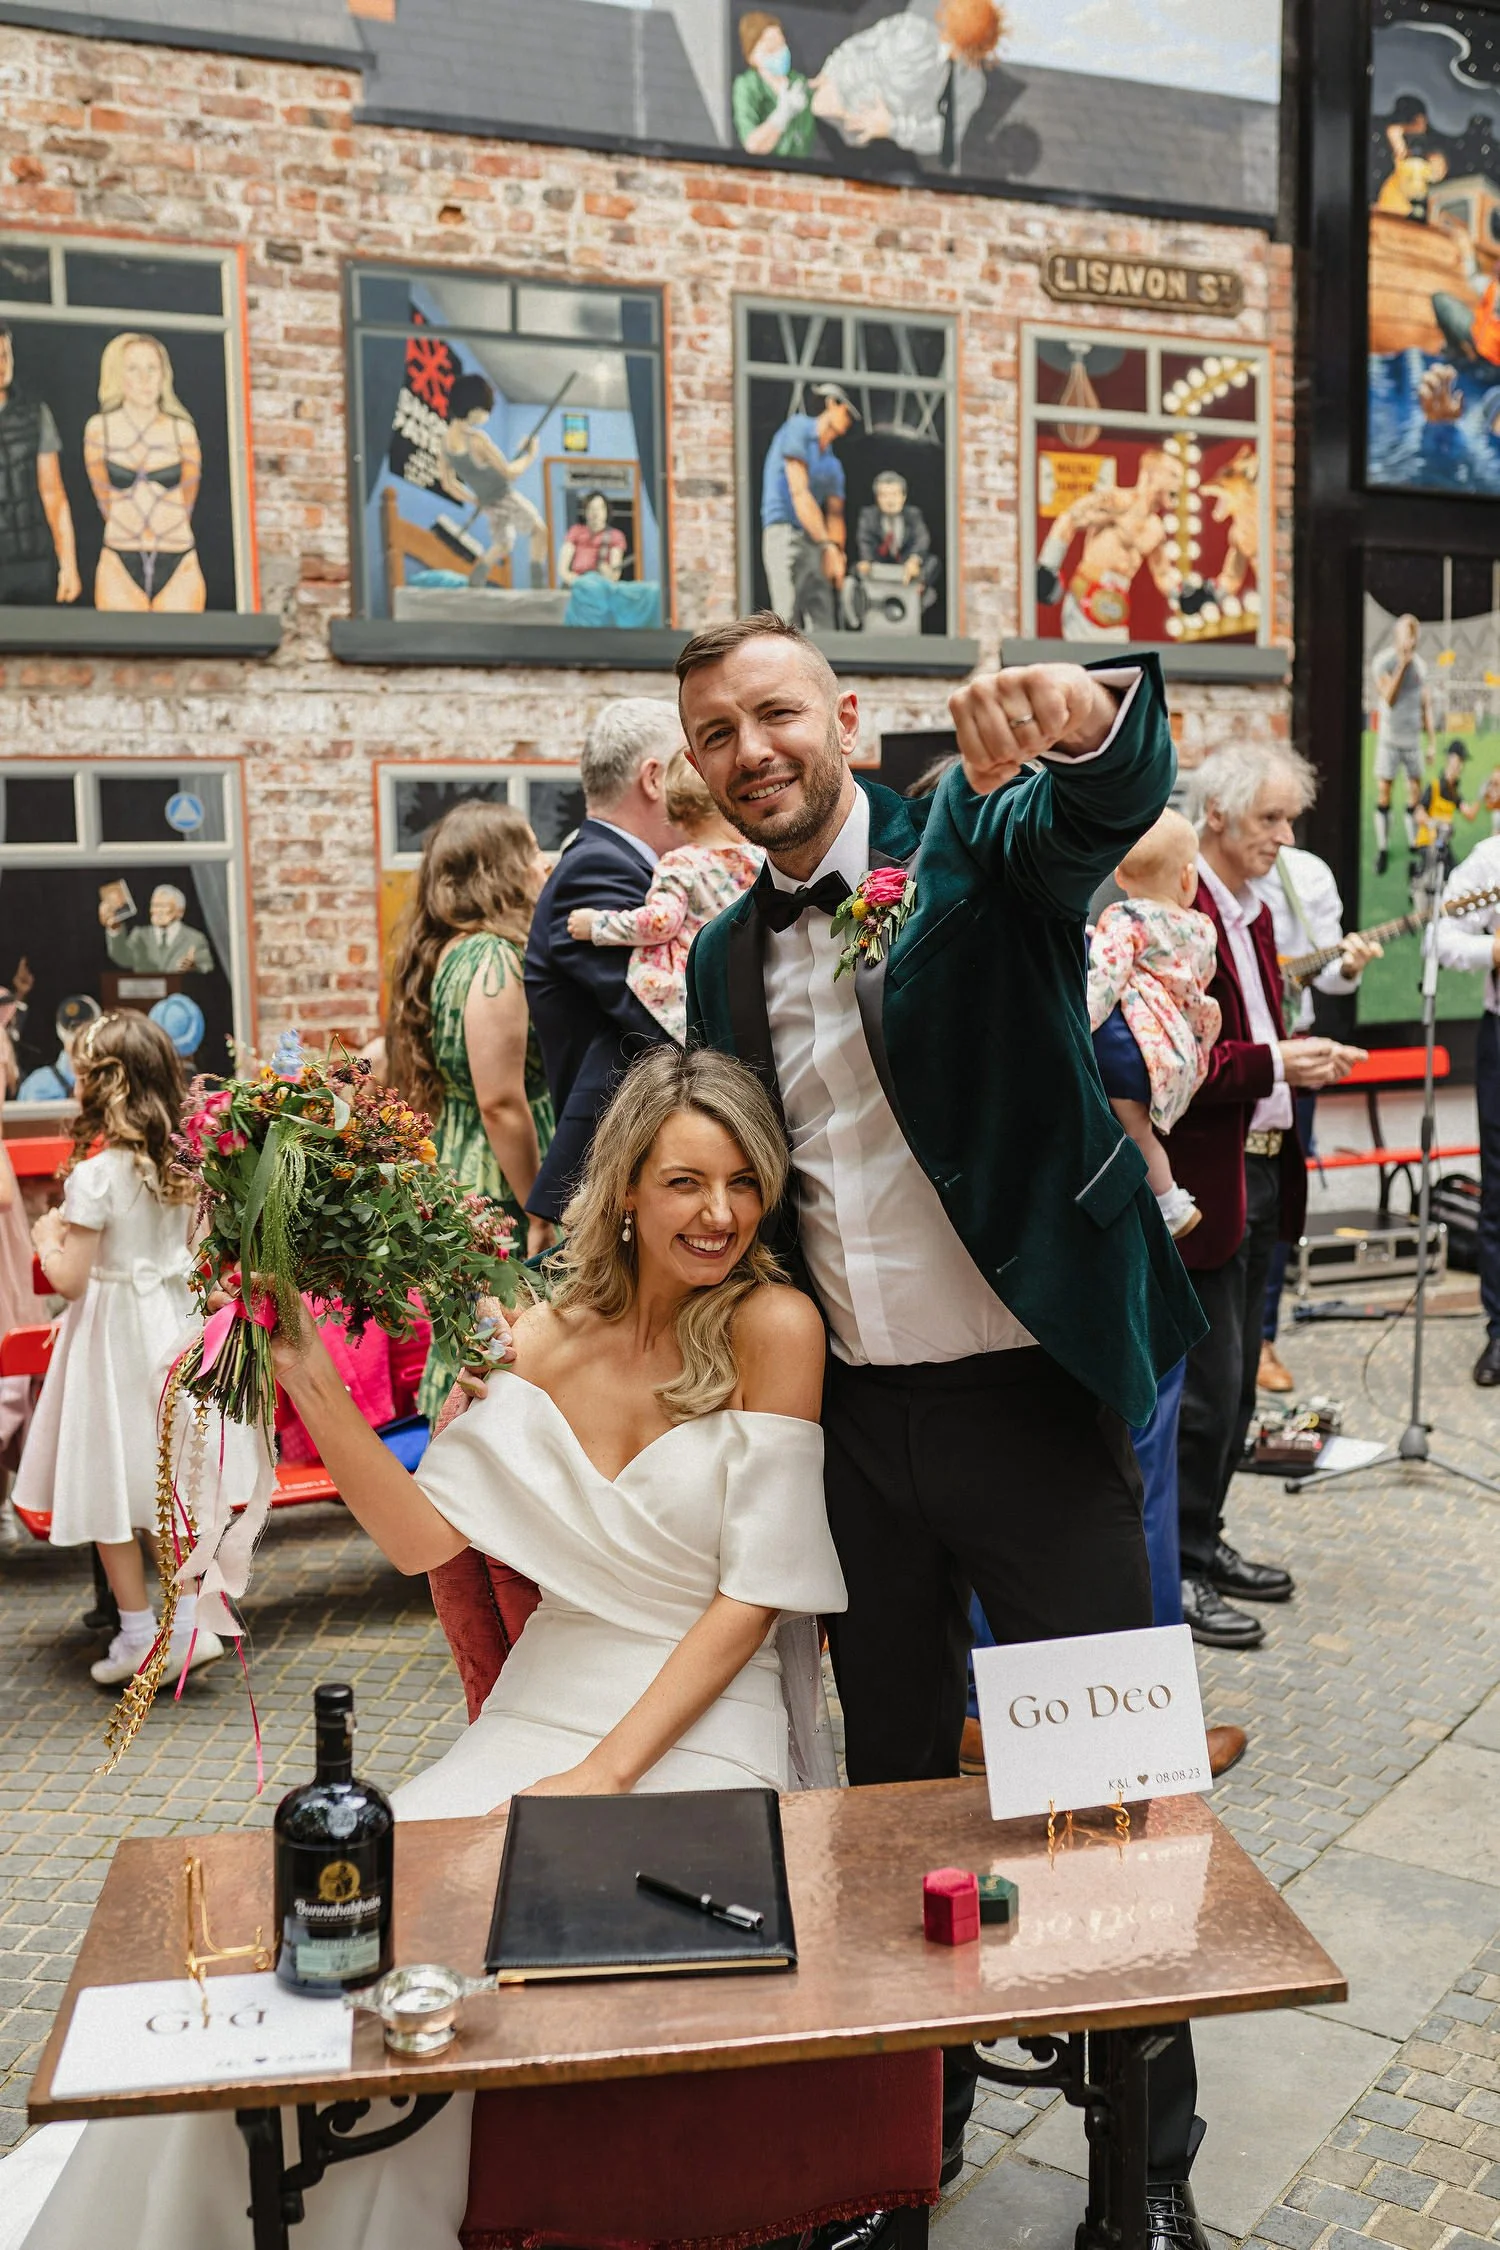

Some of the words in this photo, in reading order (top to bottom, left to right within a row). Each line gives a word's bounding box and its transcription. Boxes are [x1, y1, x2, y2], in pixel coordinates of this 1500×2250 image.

[1054, 256, 1188, 301] LISAVON
[1008, 1694, 1070, 1729] Go
[1085, 1684, 1172, 1719] Deo
[1107, 1777, 1132, 1790] K&L
[1155, 1767, 1201, 1784] 08.08.23
